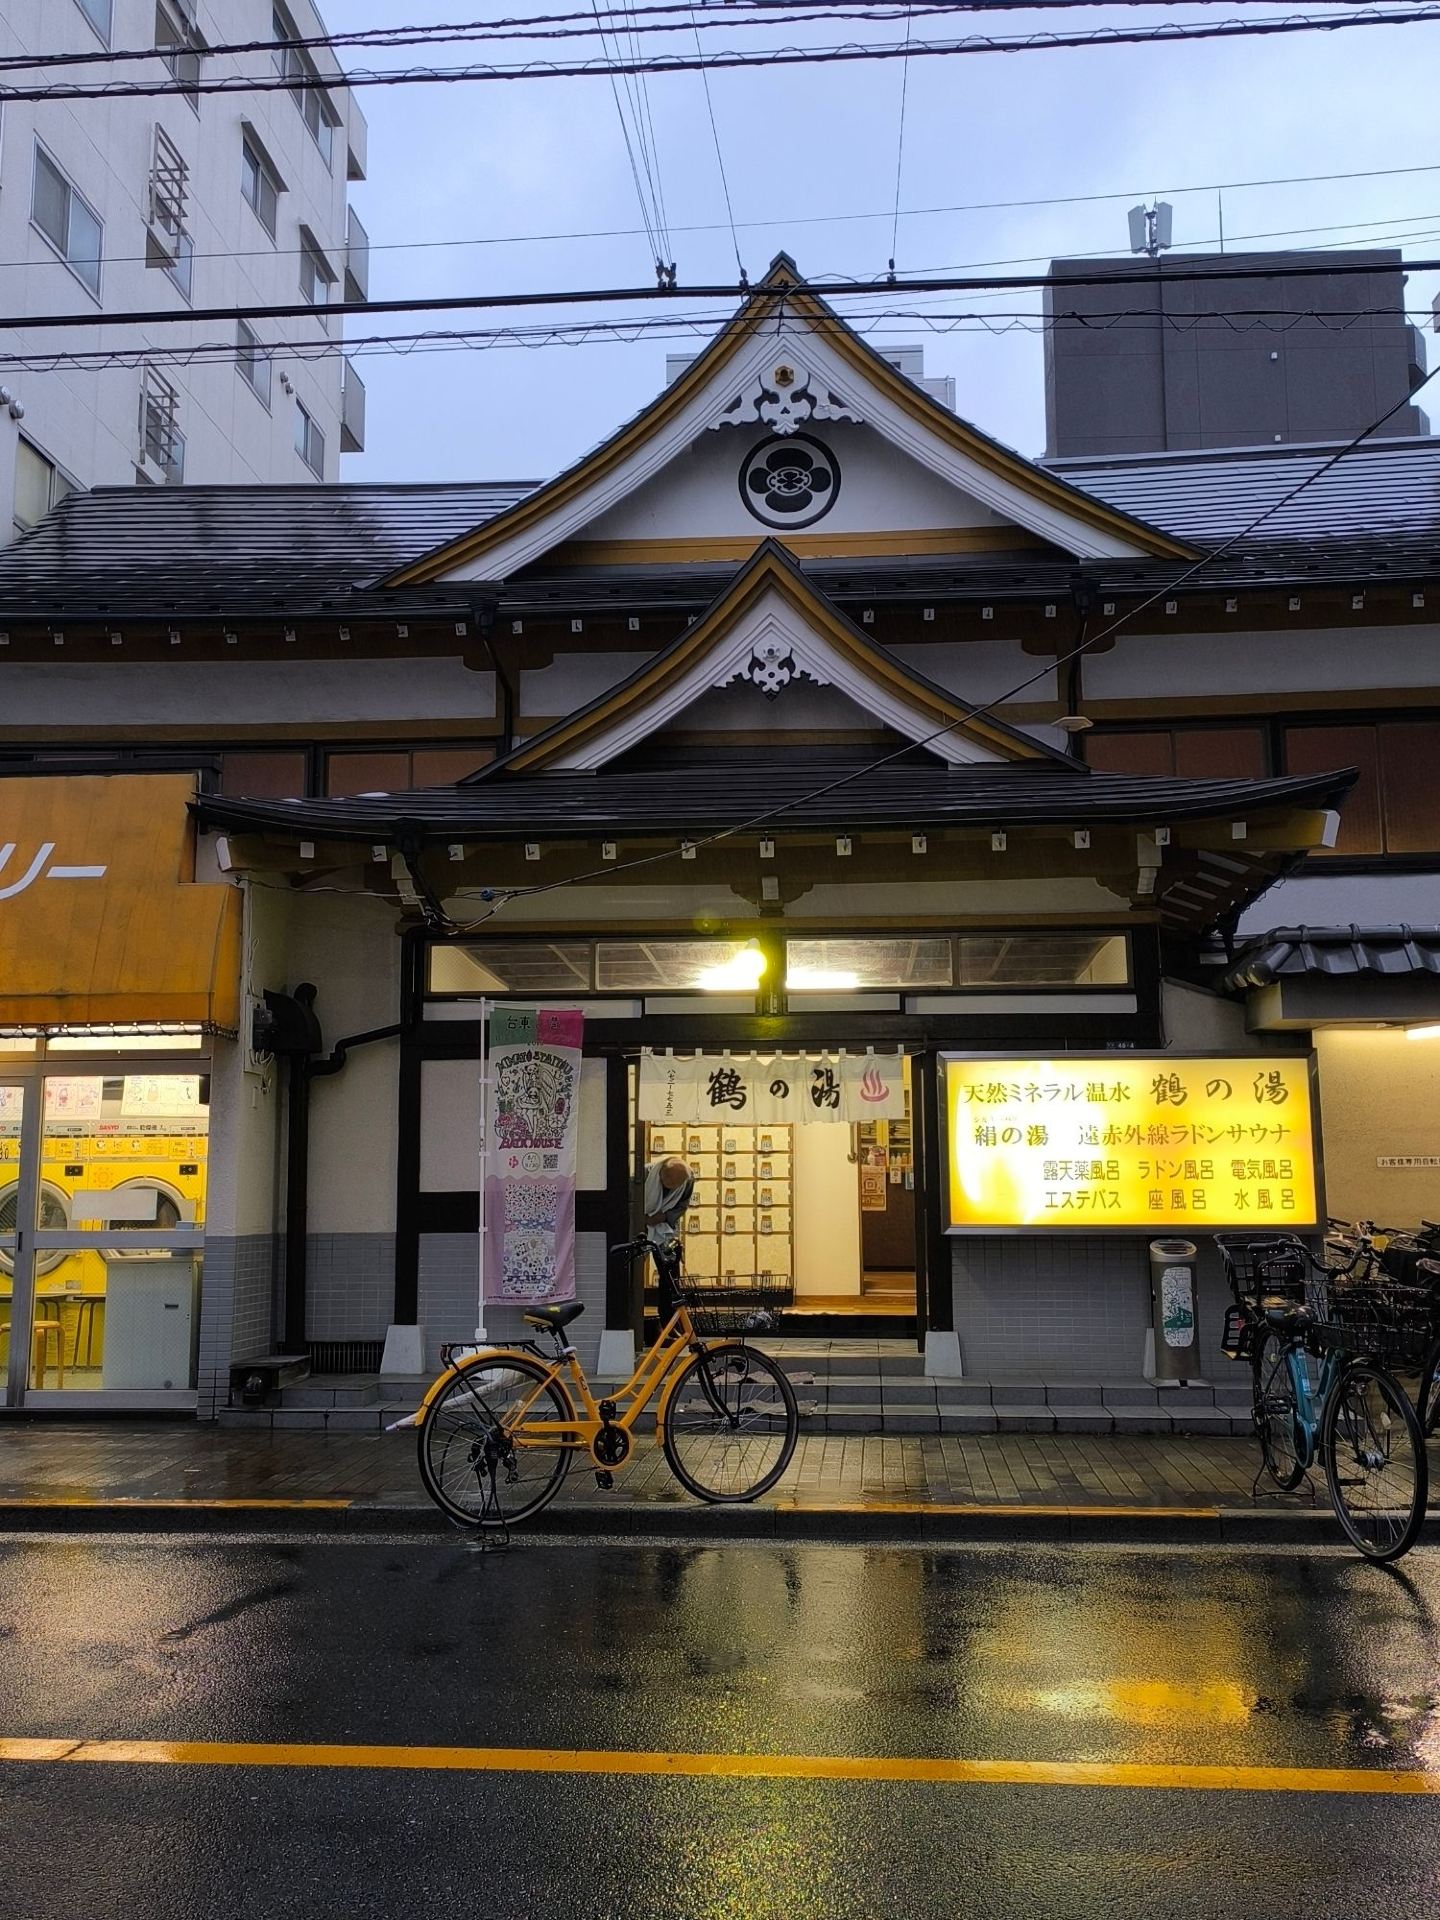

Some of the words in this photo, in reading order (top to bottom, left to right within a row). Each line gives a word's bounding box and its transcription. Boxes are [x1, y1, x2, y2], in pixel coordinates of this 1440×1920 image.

[706, 1067, 841, 1110] 鶴の湯
[963, 1081, 1131, 1104] 天然ミネラル温水
[1150, 1070, 1289, 1106] 鶴の湯
[974, 1124, 1049, 1147] 絹の湯
[1078, 1122, 1291, 1146] 遠赤外線ラドンサウナ
[508, 1155, 520, 1169] ゆ
[1043, 1160, 1120, 1181] 露天薬風呂
[1138, 1159, 1214, 1180] ラドン風呂
[1231, 1159, 1294, 1180] 電気風呂
[1381, 1158, 1440, 1167] お客様専用自転
[1148, 1189, 1207, 1210] 座風呂
[1234, 1189, 1295, 1209] 水風呂
